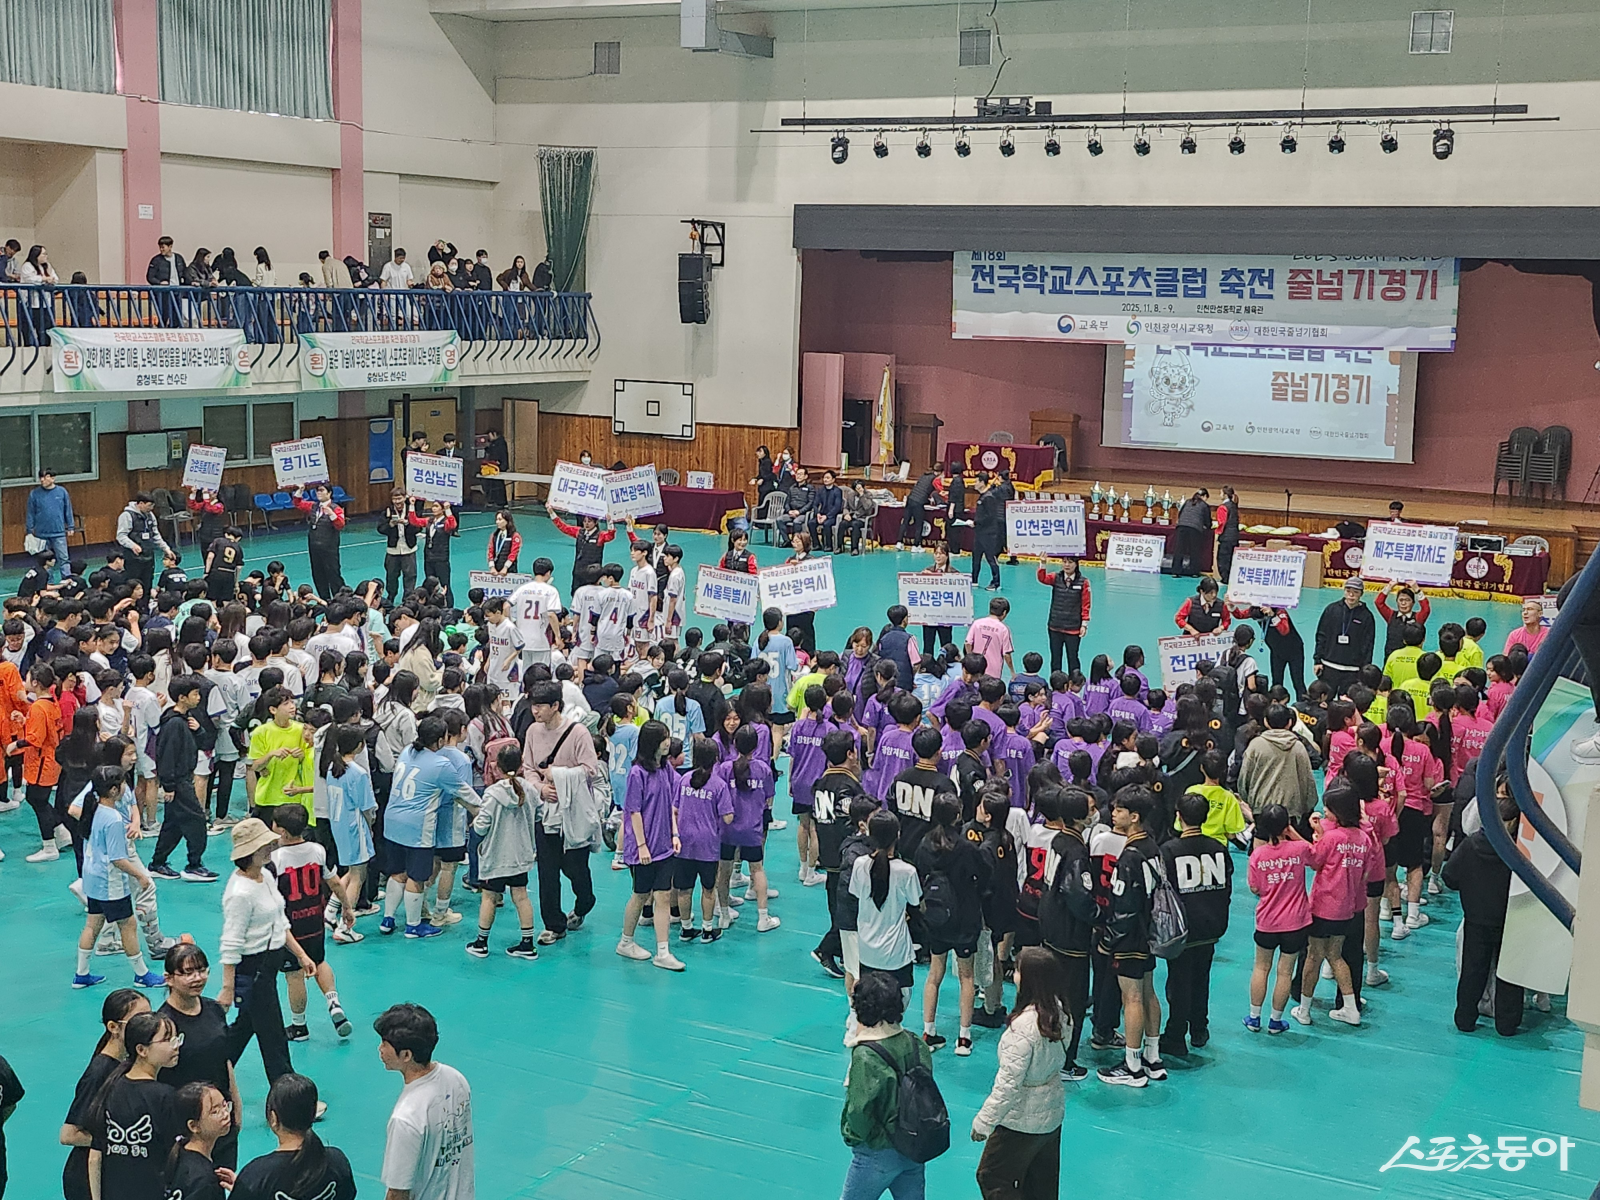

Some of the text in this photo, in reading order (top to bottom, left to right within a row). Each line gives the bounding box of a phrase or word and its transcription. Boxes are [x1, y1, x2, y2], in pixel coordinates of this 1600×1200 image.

[971, 264, 1438, 301] 전국학교스포츠클럽 축전 줄넘기경기
[1079, 319, 1108, 331] 교육부
[1144, 322, 1214, 334] 인천광역시교육청
[1254, 325, 1328, 338] 대한민국줄넘기협회
[63, 350, 79, 369] 환
[309, 352, 324, 370] 환
[445, 349, 456, 365] 영
[136, 373, 187, 386] 충청북도 선수단
[1271, 371, 1371, 404] 줄넘기경기
[280, 453, 321, 472] 경기도
[413, 467, 458, 488] 경상남도
[557, 477, 606, 501] 대구광역시
[610, 481, 655, 504] 대전광역시
[1015, 518, 1078, 536] 인천광역시
[223, 546, 235, 563] 9
[1115, 543, 1153, 558] 종합우승
[1372, 540, 1447, 564] 제주특별자치도
[768, 574, 827, 599] 부산광역시
[1237, 566, 1297, 587] 전북특별자치도
[702, 582, 751, 606] 서울특별시
[907, 590, 966, 607] 울산광역시
[524, 600, 540, 620] 21
[610, 607, 618, 625] 4
[981, 633, 993, 656] 7
[814, 790, 836, 820] DN
[895, 781, 934, 819] DN
[1031, 847, 1047, 880] 9
[1175, 852, 1226, 889] DN
[285, 862, 321, 901] 10
